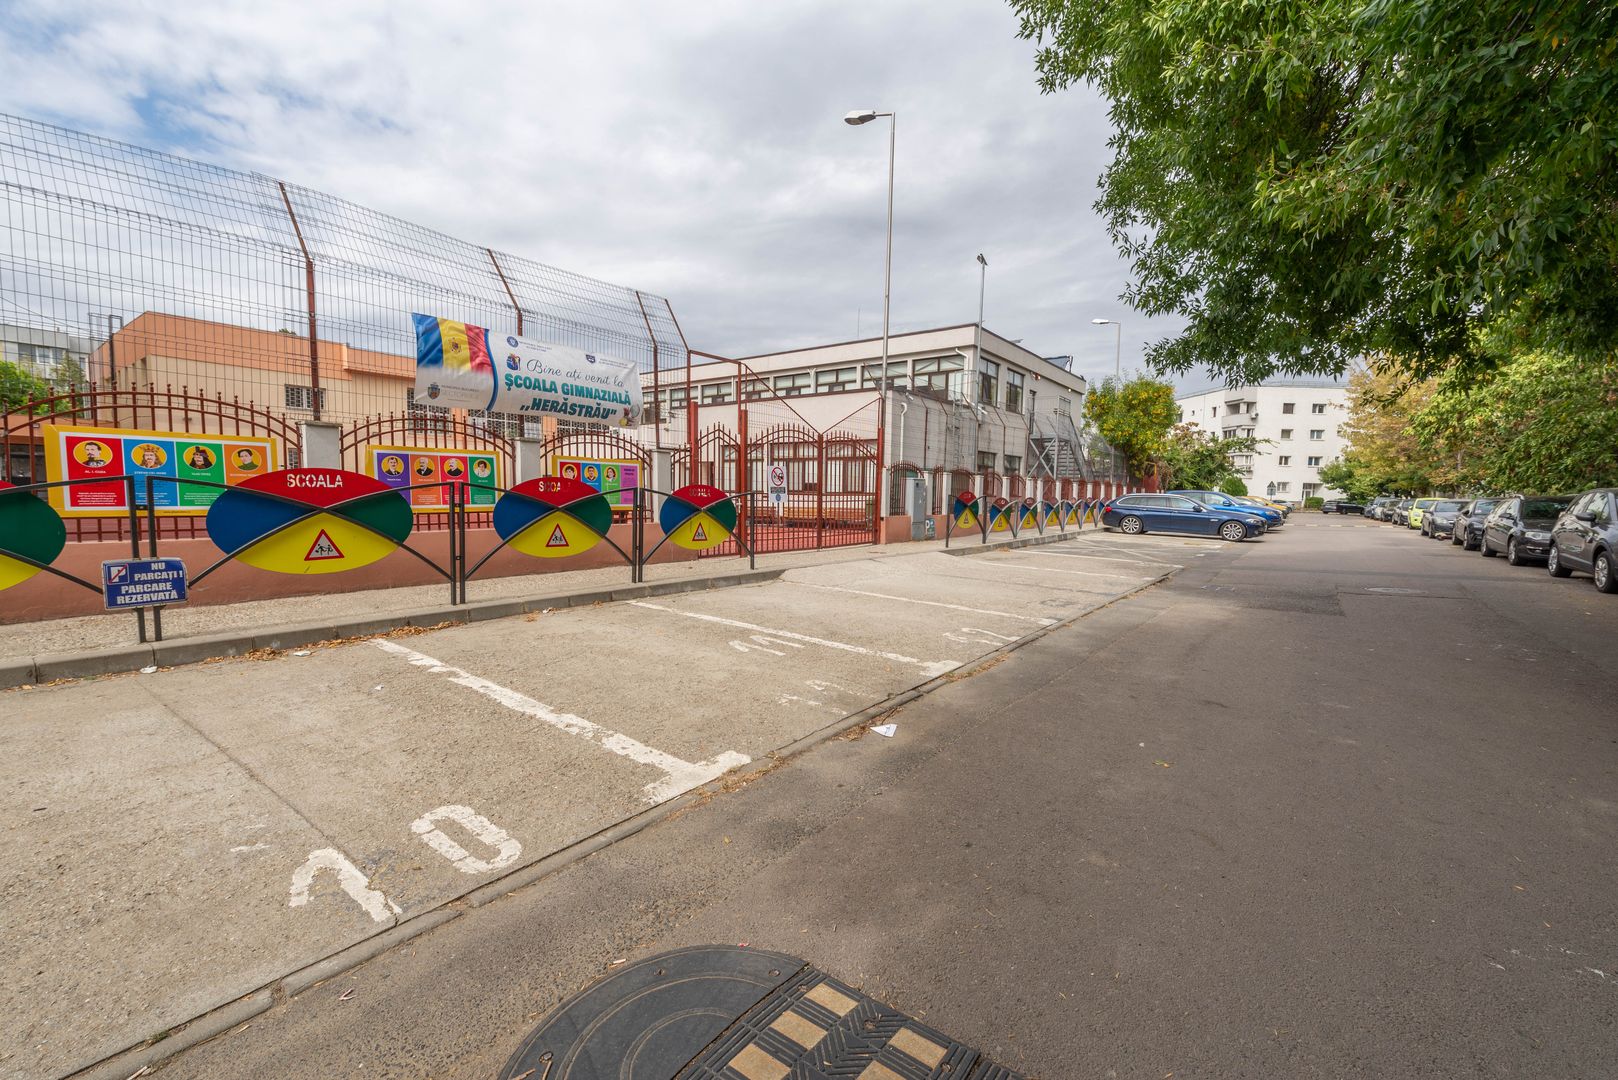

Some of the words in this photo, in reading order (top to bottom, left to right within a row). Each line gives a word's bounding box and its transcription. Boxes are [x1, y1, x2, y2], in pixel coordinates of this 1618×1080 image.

[526, 359, 562, 376] Bine
[585, 374, 610, 385] venit
[613, 376, 625, 388] la
[561, 382, 632, 406] GIMNAZIALĂ
[286, 473, 343, 488] SCOALA
[151, 562, 166, 571] NU
[121, 581, 173, 594] PARCARE
[116, 590, 179, 605] REZERVATĂ
